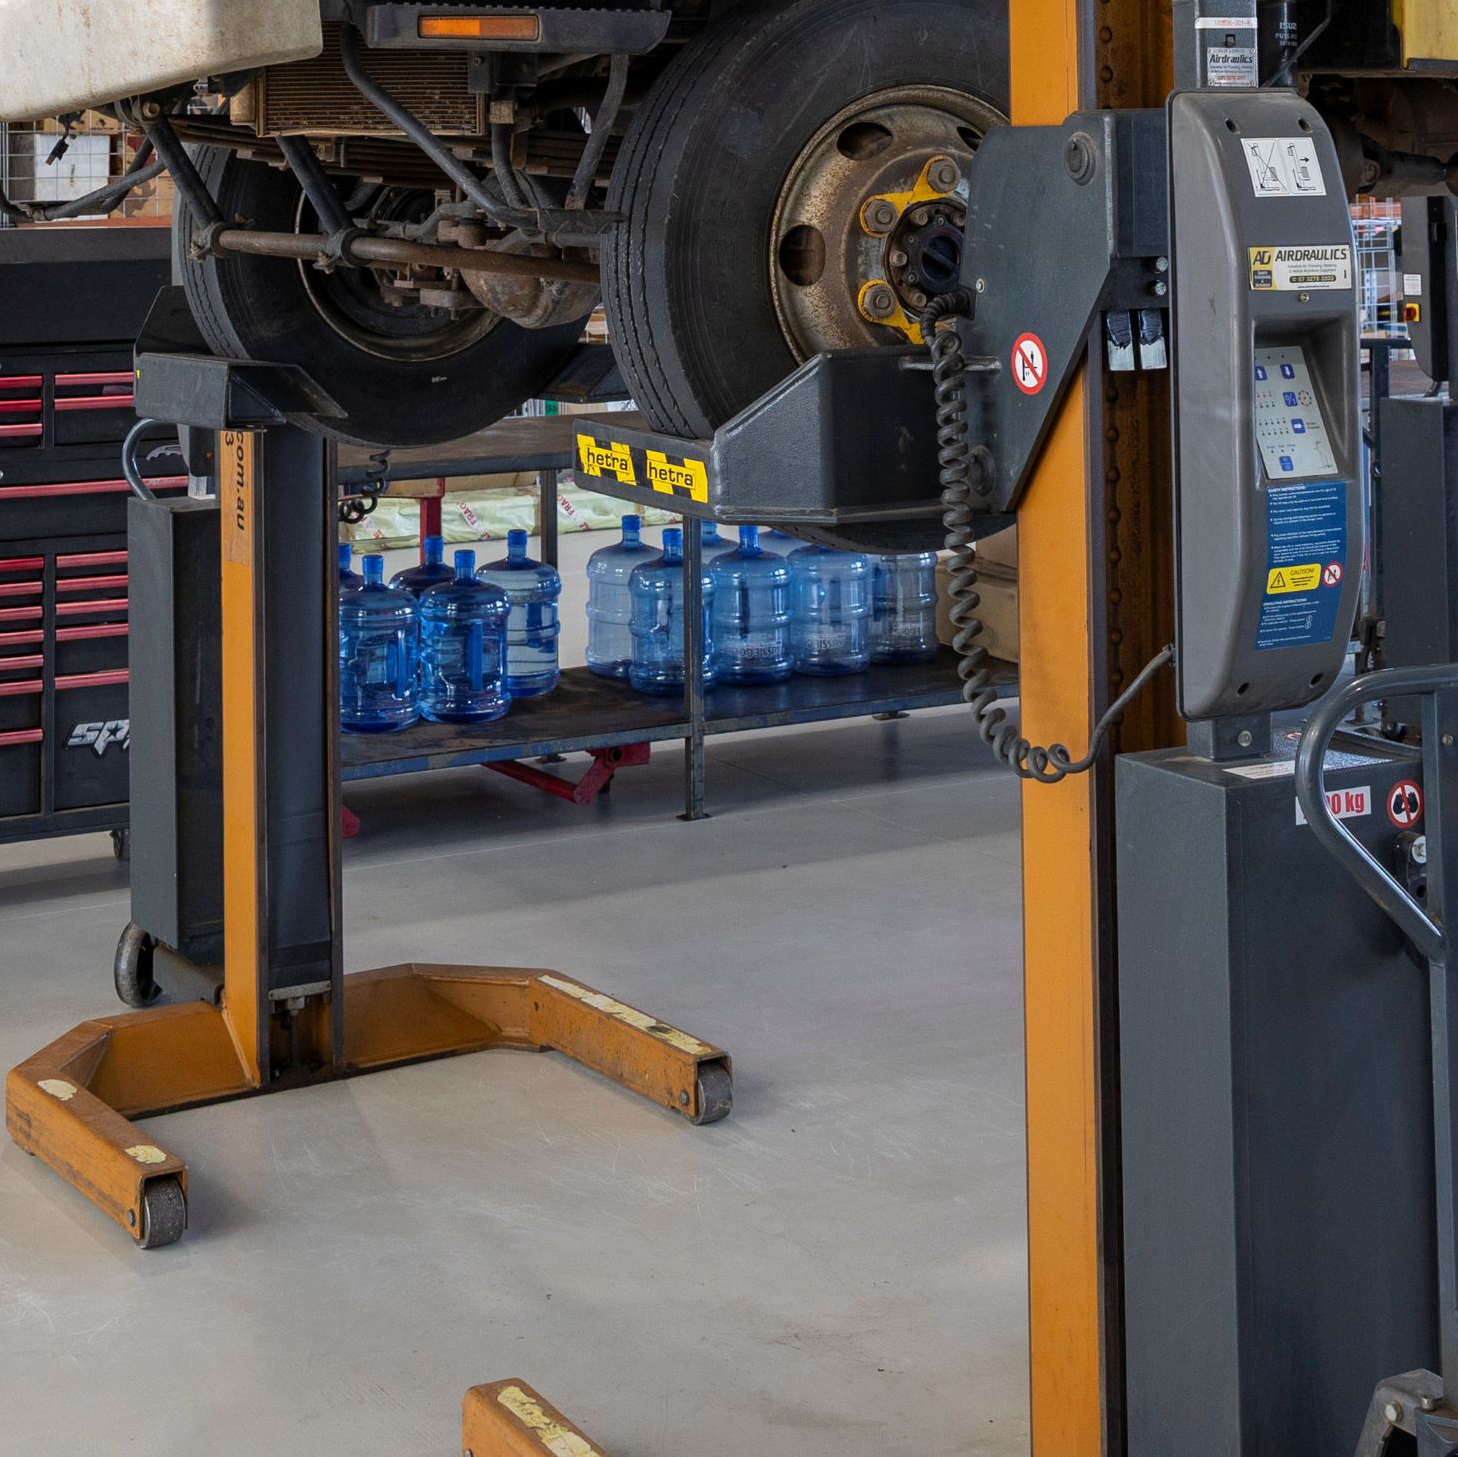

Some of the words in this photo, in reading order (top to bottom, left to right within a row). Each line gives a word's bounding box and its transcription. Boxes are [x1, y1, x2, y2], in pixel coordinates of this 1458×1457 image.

[1209, 54, 1253, 64] Airdraulics
[1275, 248, 1347, 262] AIRDRAULICS
[586, 446, 628, 472] hetra
[648, 462, 694, 487] hetra
[1346, 792, 1365, 814] kg
